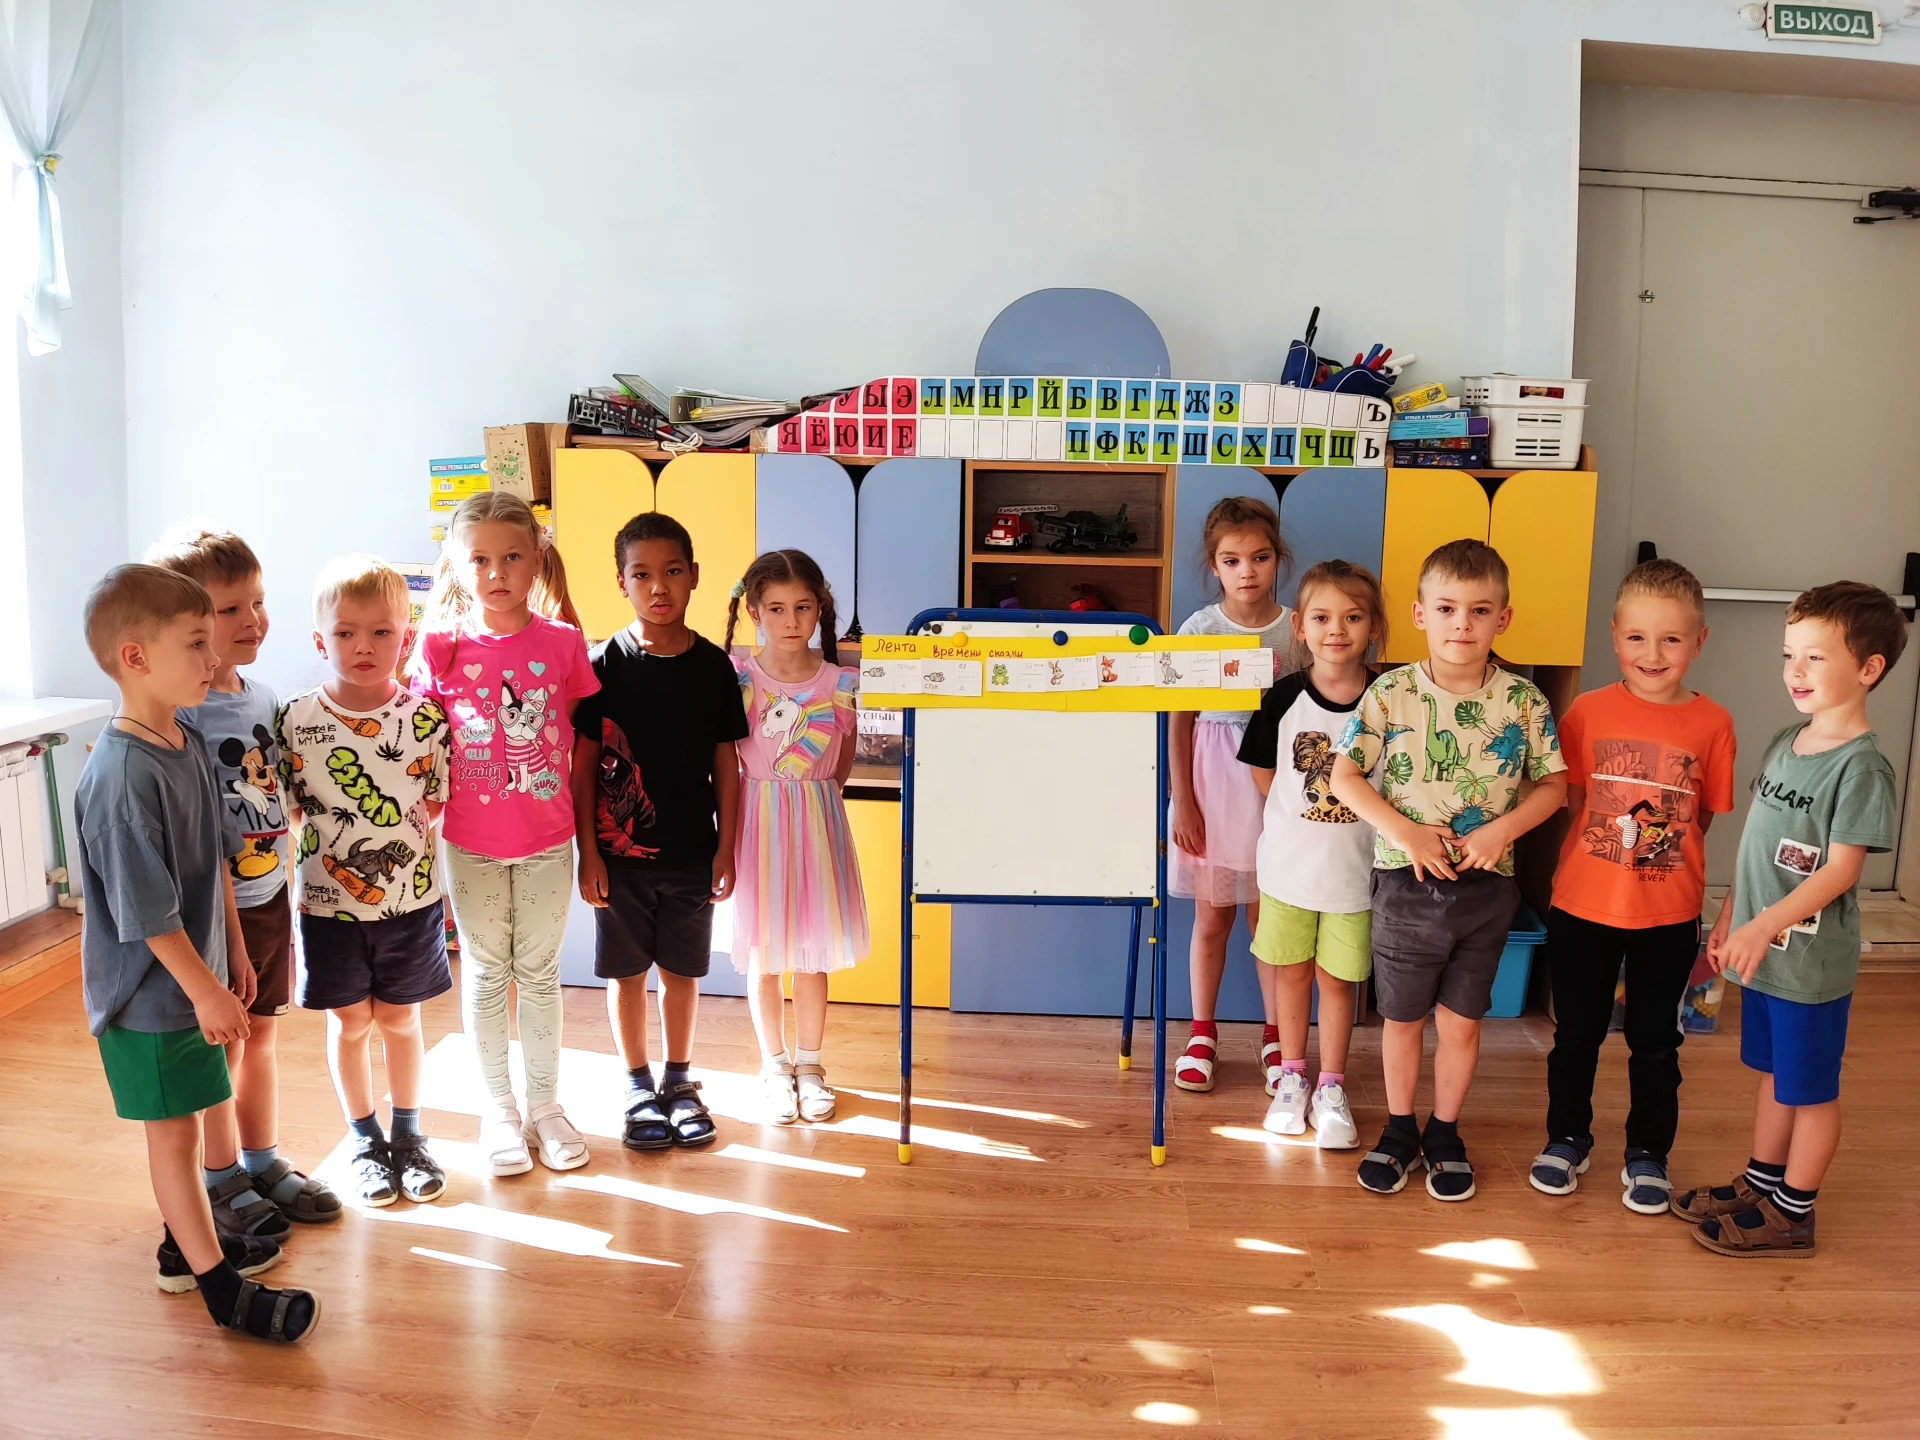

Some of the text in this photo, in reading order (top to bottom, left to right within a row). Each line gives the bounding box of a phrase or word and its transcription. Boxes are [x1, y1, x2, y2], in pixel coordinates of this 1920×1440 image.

[1780, 10, 1868, 35] ВЫХОД
[863, 385, 887, 407] Ы
[898, 387, 912, 407] Э
[924, 386, 943, 407] Л
[954, 386, 975, 407] М
[983, 386, 1002, 408] Н
[1012, 386, 1027, 408] Р
[1041, 381, 1060, 409] Й
[1070, 387, 1086, 409] Б
[1101, 388, 1117, 410] В
[1131, 388, 1146, 411] Г
[1158, 389, 1176, 418] Д
[1185, 390, 1209, 413] Ж
[1219, 391, 1233, 414] З
[1368, 404, 1386, 421] Ъ
[781, 418, 1379, 463] Я Ё Ю И Е П Ф К Т Ш С Х Ц Ч Щ Ь
[873, 638, 916, 653] Лента
[988, 649, 1023, 659] сказки
[298, 735, 312, 747] MY
[452, 754, 505, 791] Beauty
